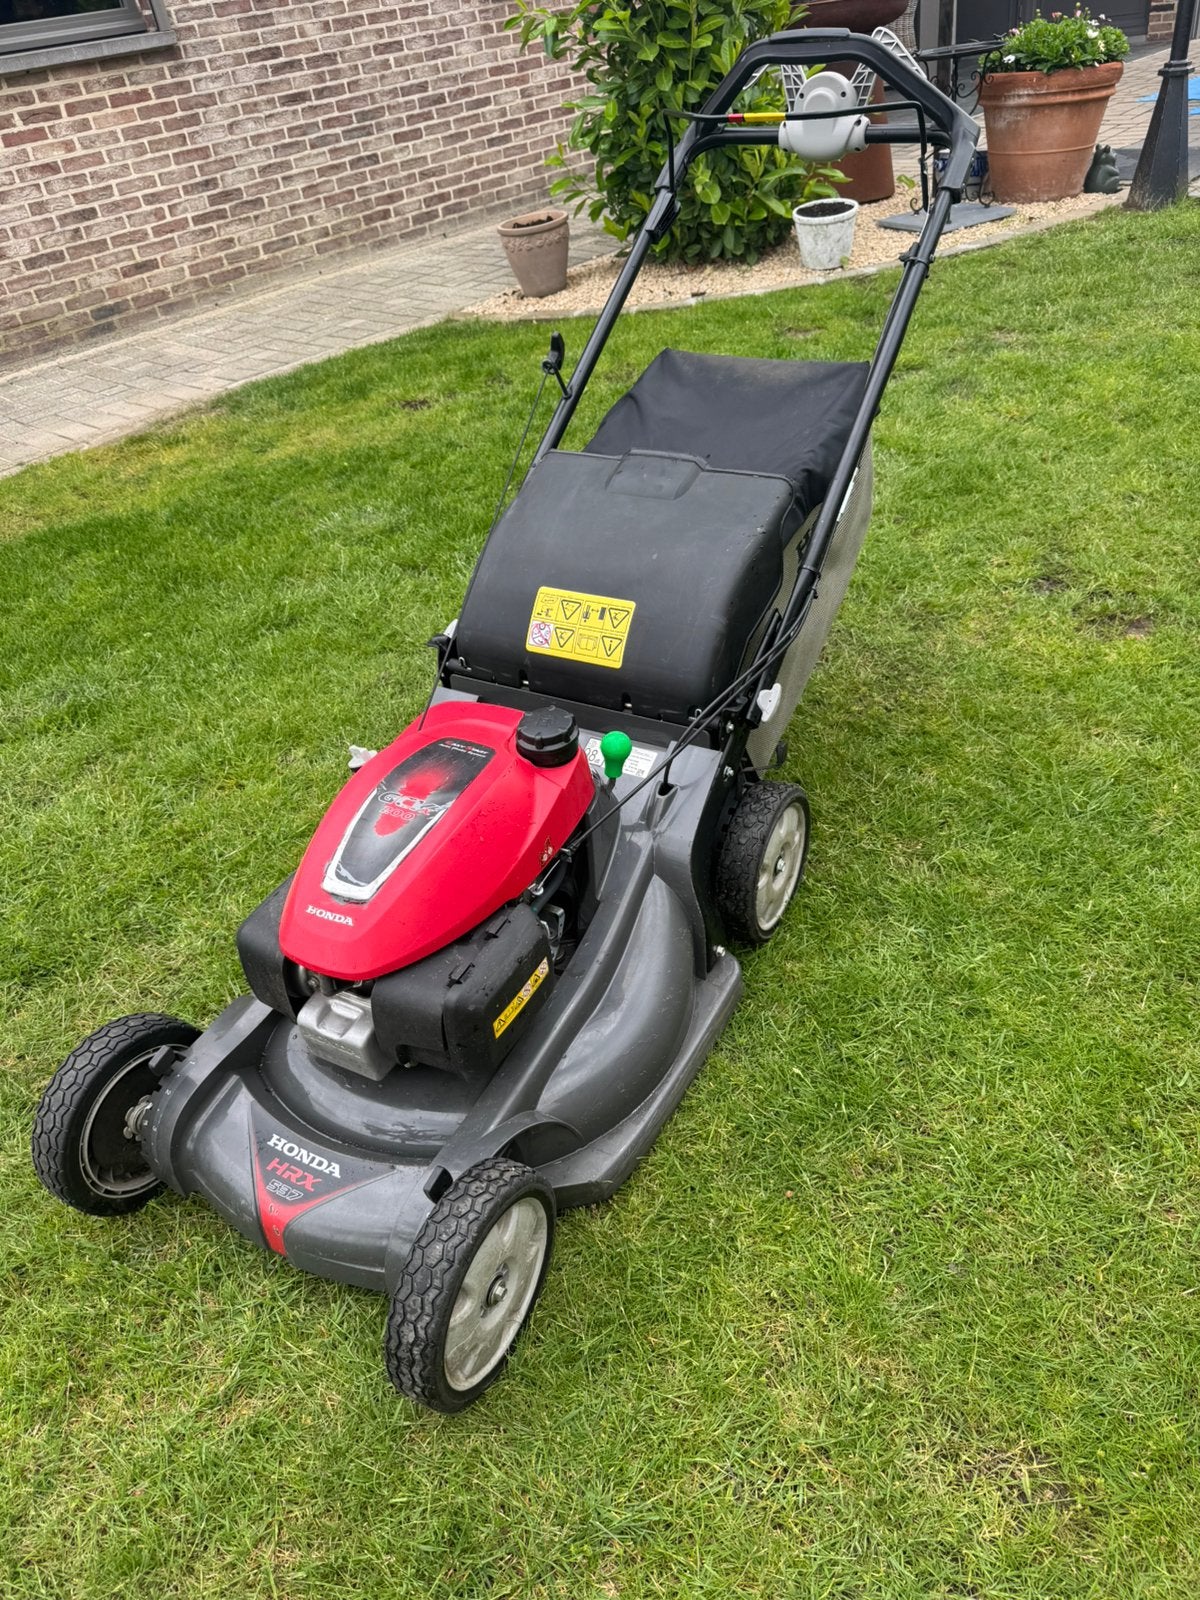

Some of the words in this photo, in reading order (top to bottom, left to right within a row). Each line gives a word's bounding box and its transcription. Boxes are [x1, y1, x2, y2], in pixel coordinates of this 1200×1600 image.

[306, 904, 353, 926] HONDA
[266, 1133, 341, 1179] HONDA
[265, 1158, 322, 1192] HRX
[266, 1179, 302, 1201] 537
